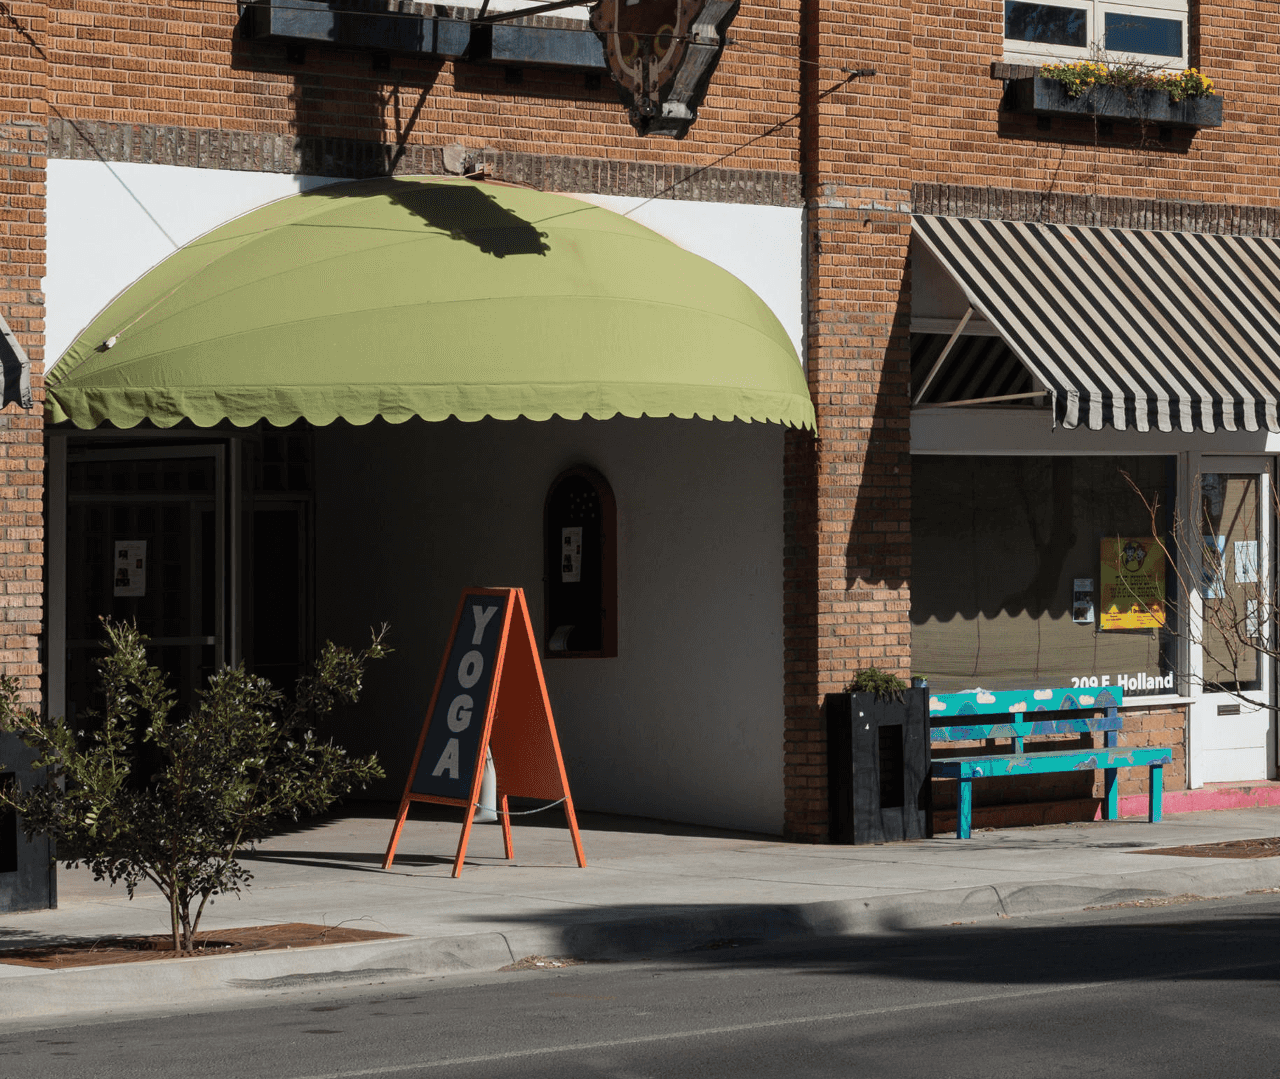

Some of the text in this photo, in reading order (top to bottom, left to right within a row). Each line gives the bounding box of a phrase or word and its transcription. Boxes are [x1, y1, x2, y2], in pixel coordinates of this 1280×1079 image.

[432, 605, 499, 780] YOGA
[1070, 676, 1099, 688] 209
[1118, 671, 1174, 690] Holland
